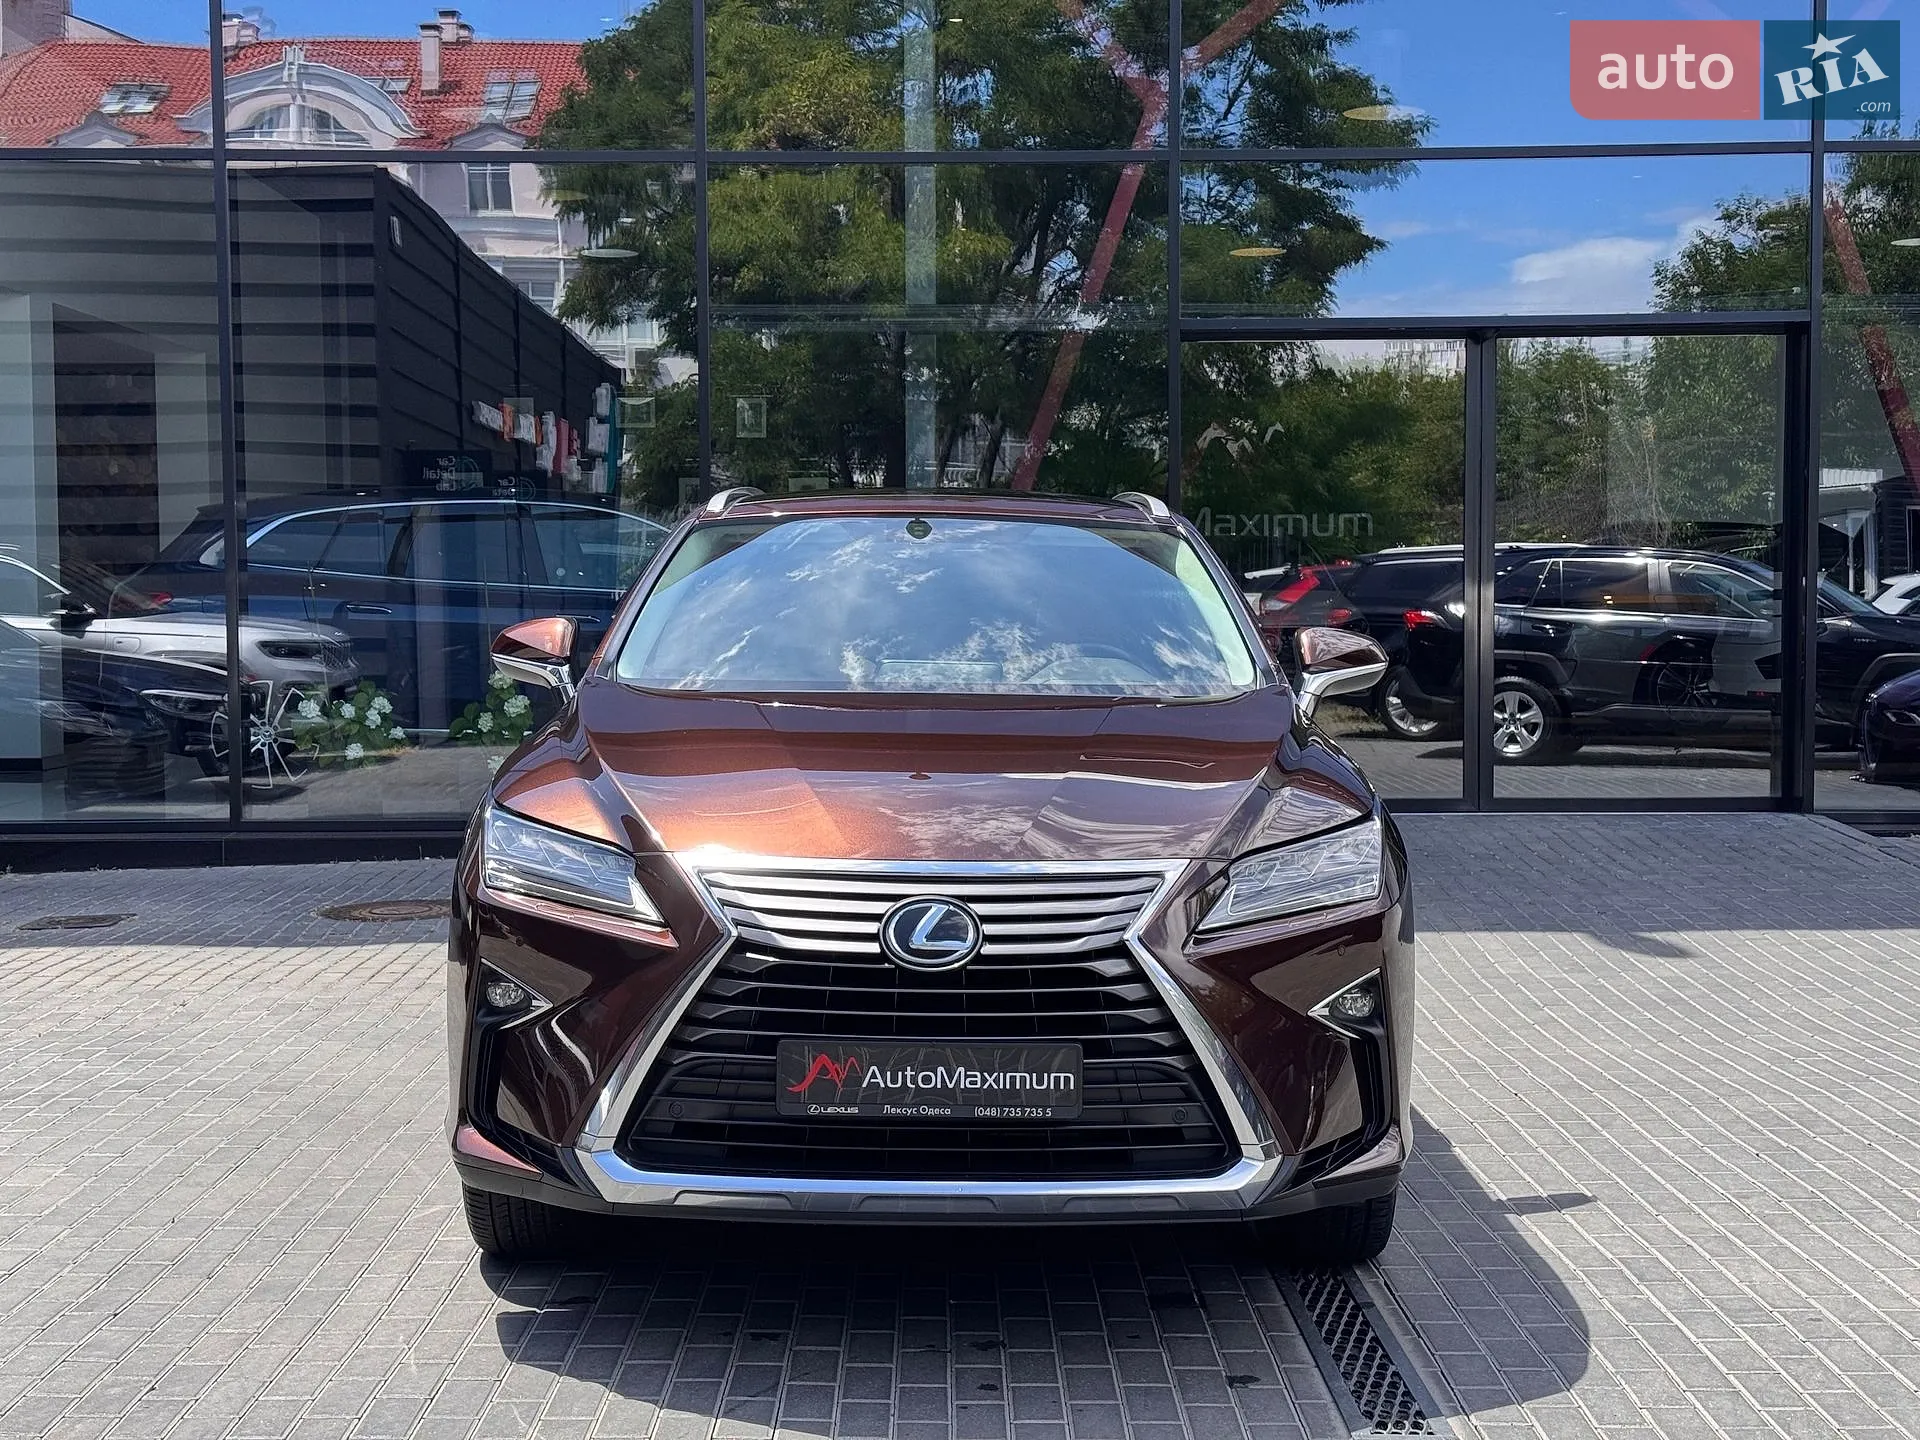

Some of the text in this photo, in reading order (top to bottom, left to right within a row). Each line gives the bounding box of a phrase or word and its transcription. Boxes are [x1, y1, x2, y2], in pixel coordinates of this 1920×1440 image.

[862, 1066, 1075, 1090] AutoMaximum
[821, 1106, 859, 1114] LEXUS
[883, 1105, 917, 1116] Лексус
[974, 1106, 1052, 1117] (048) 735 735 5
